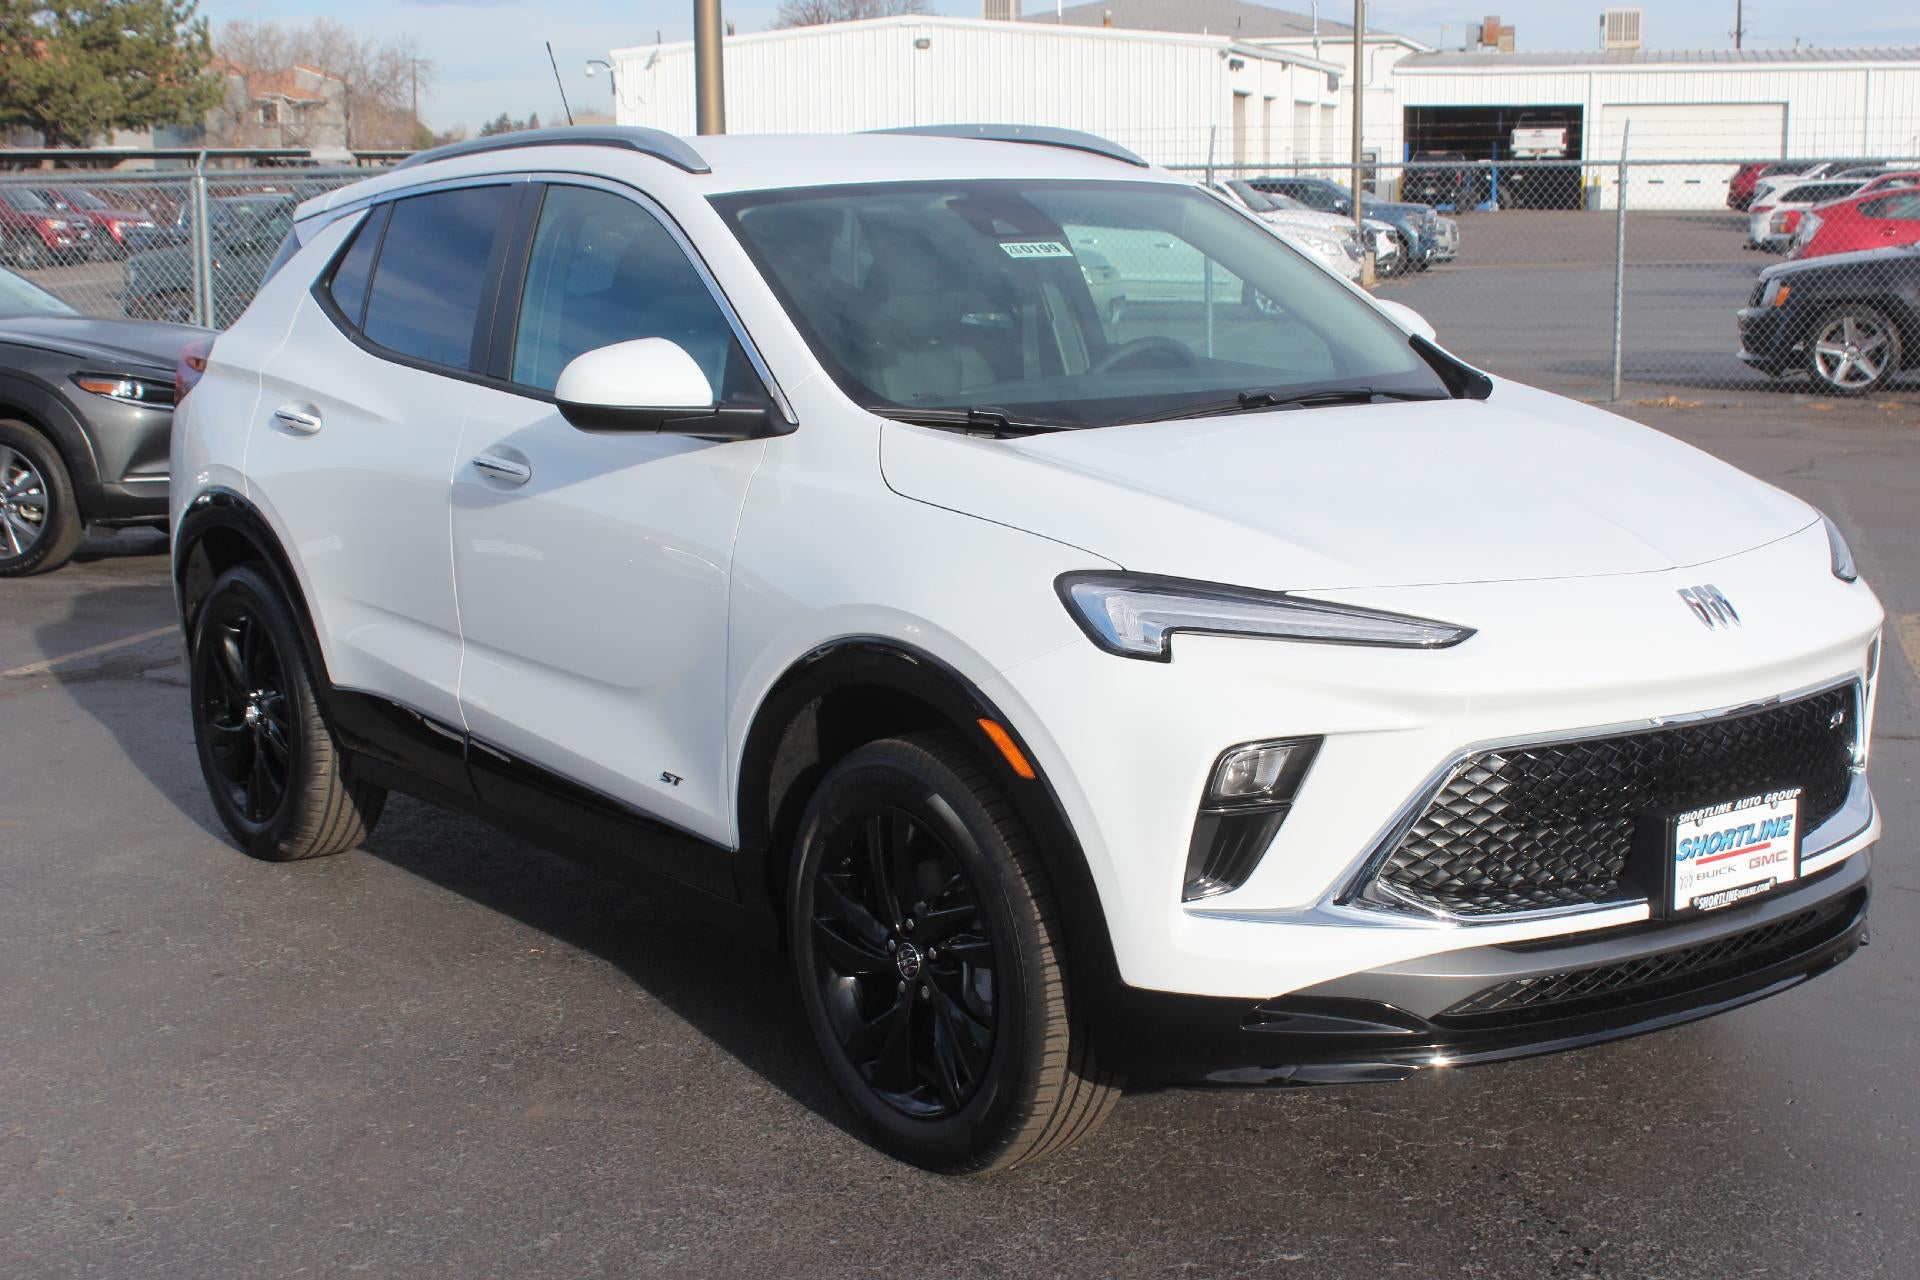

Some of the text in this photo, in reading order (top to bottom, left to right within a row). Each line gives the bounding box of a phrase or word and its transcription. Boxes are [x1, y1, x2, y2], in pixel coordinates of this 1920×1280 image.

[660, 771, 684, 786] ST
[1678, 788, 1802, 825] SHORTLINE AUTO GROUP
[1675, 814, 1793, 862] SHORTLINE
[1749, 850, 1788, 870] GMC
[1696, 864, 1737, 881] BUICK
